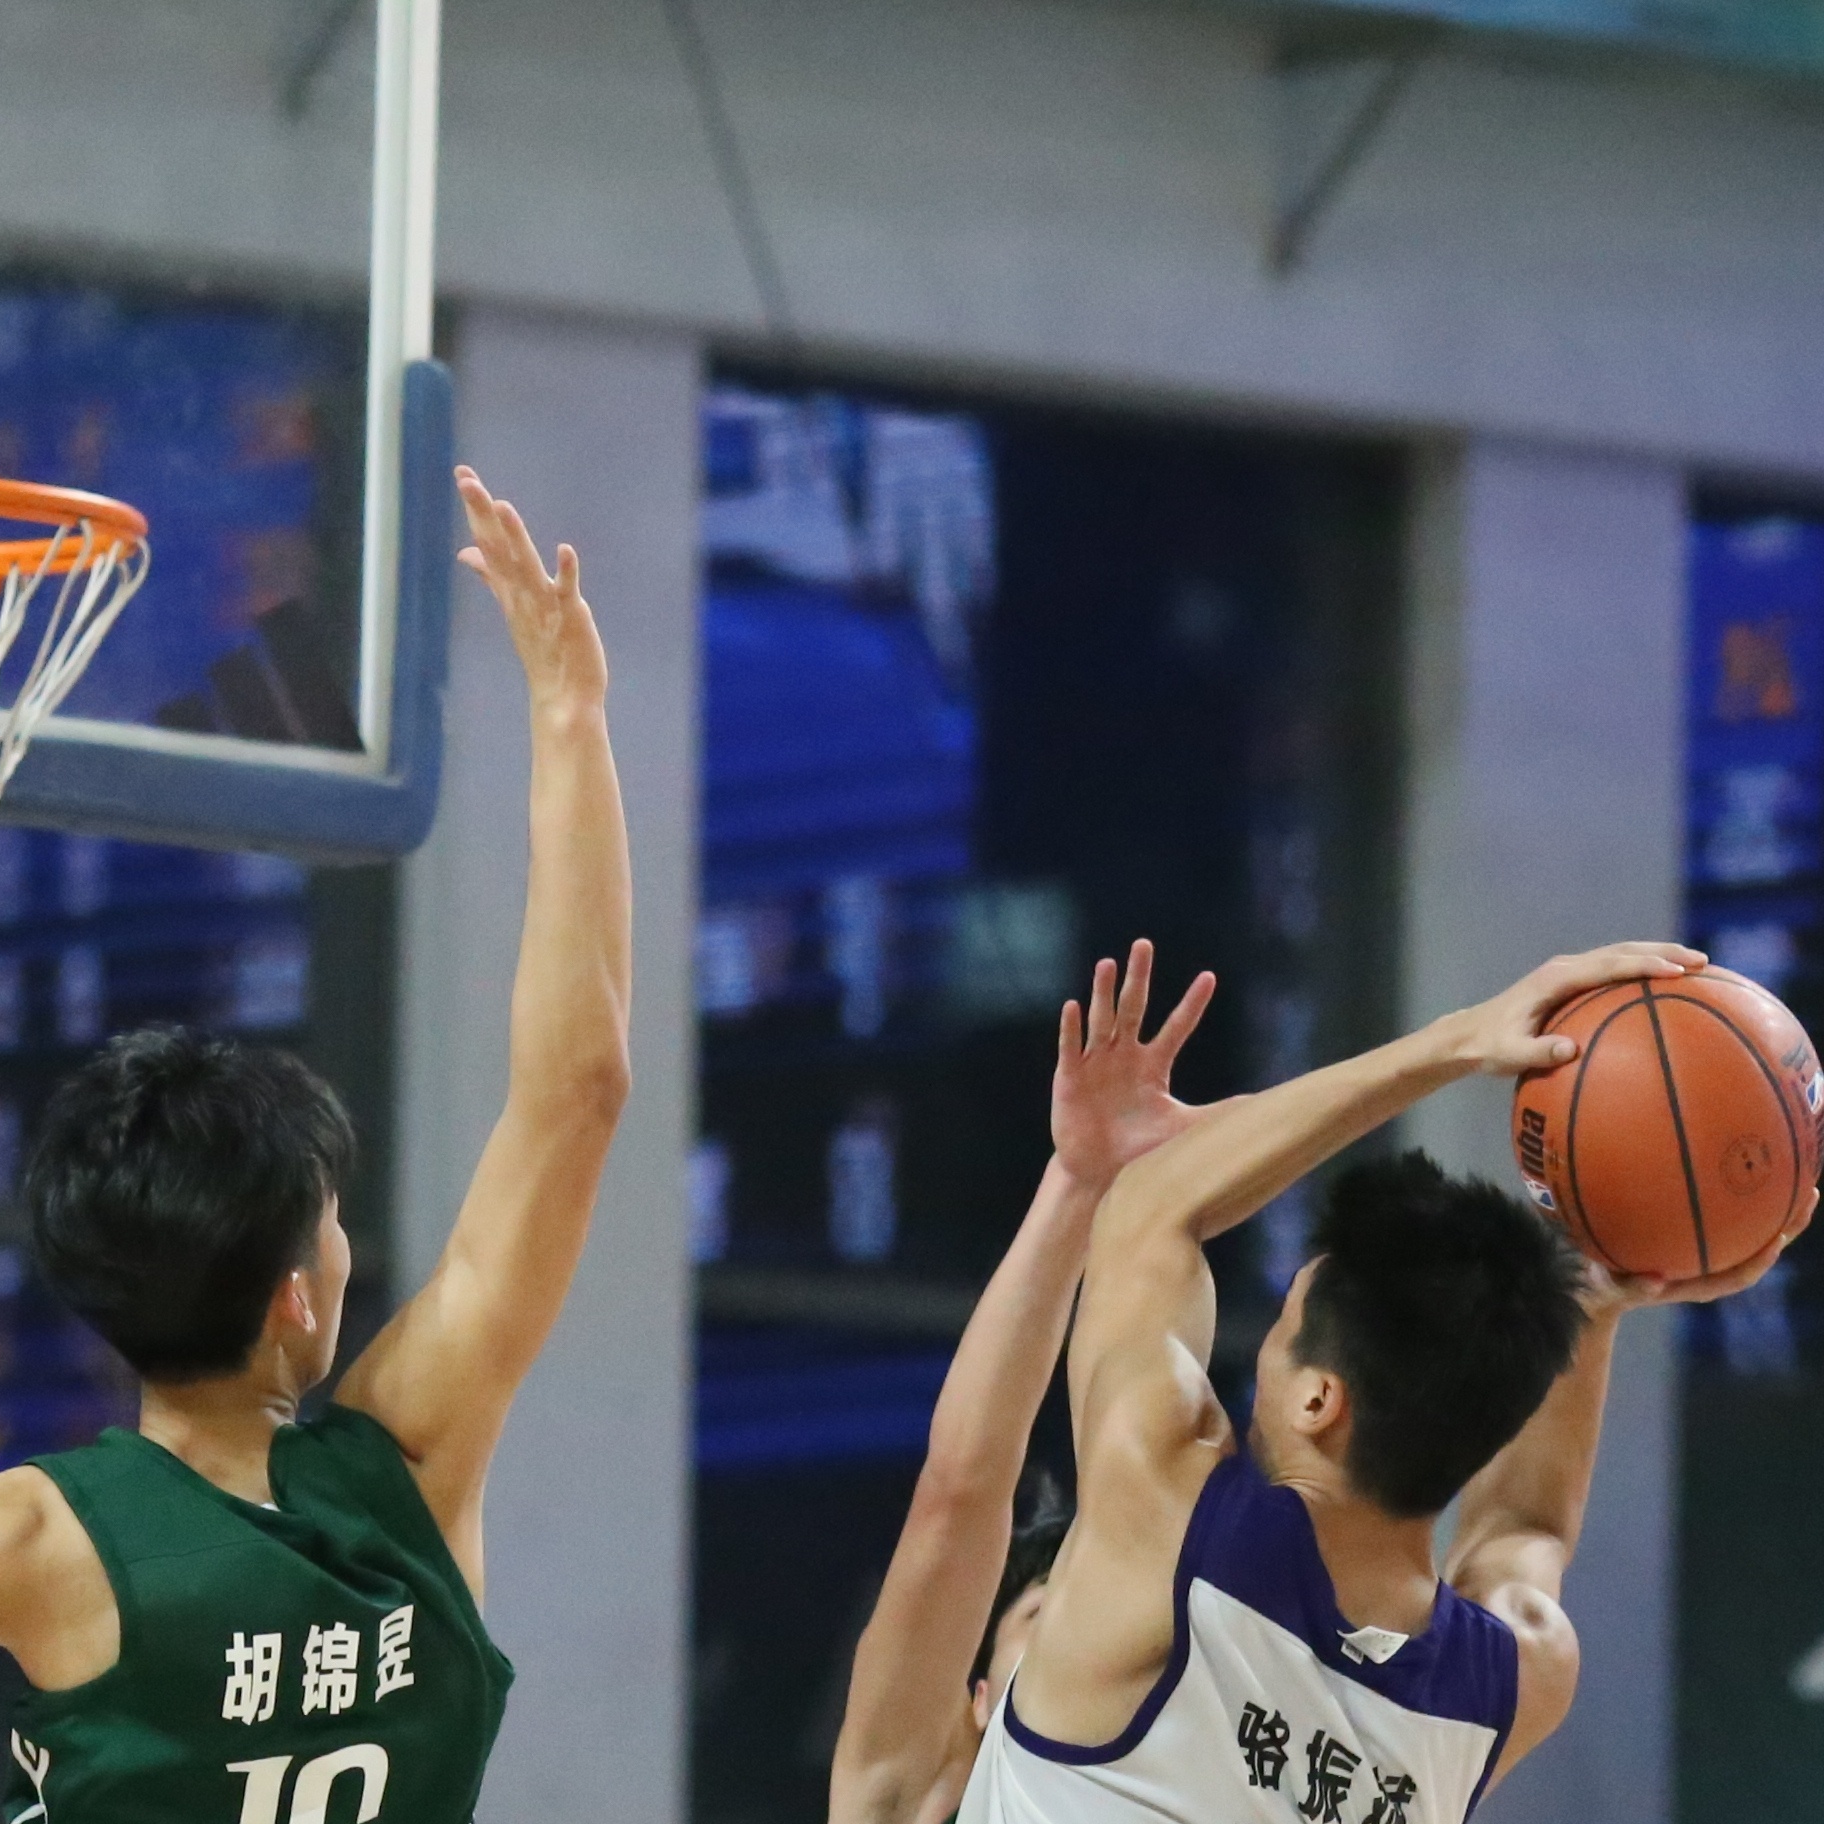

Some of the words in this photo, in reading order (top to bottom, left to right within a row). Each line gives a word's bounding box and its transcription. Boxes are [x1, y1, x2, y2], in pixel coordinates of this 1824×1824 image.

[1518, 1108, 1546, 1181] nba
[222, 1604, 415, 1726] 胡锦昱
